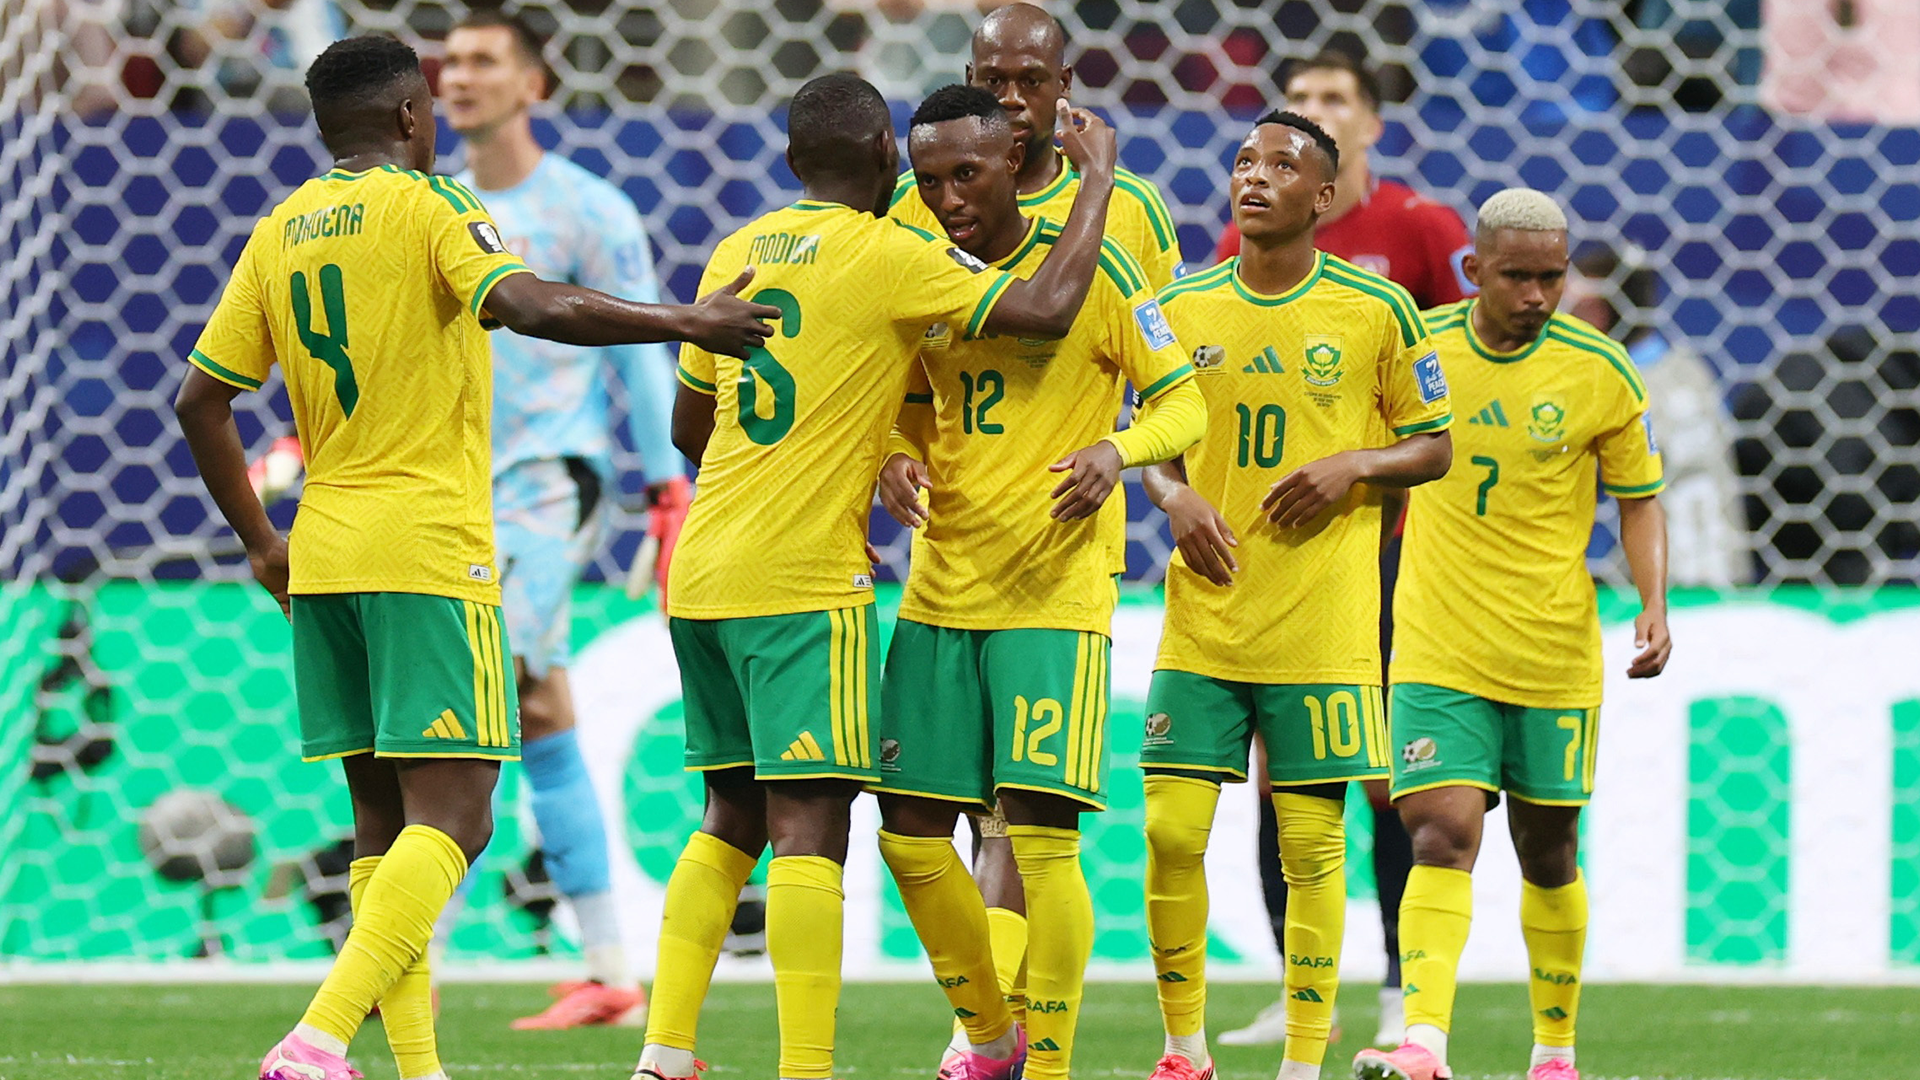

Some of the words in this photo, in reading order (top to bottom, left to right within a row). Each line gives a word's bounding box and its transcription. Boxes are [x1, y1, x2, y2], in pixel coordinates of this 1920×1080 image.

[283, 203, 365, 251] MOKOENA
[291, 264, 359, 421] 4
[738, 288, 801, 445] 6
[960, 370, 1004, 434] 12
[1236, 403, 1286, 468] 10
[1470, 455, 1500, 516] 7
[1013, 695, 1064, 766] 12
[1303, 690, 1361, 760] 10
[1557, 716, 1581, 781] 7
[937, 975, 969, 988] AFA
[1290, 954, 1333, 968] SAFA
[1533, 968, 1577, 986] SAFA
[1025, 997, 1068, 1013] SAFA
